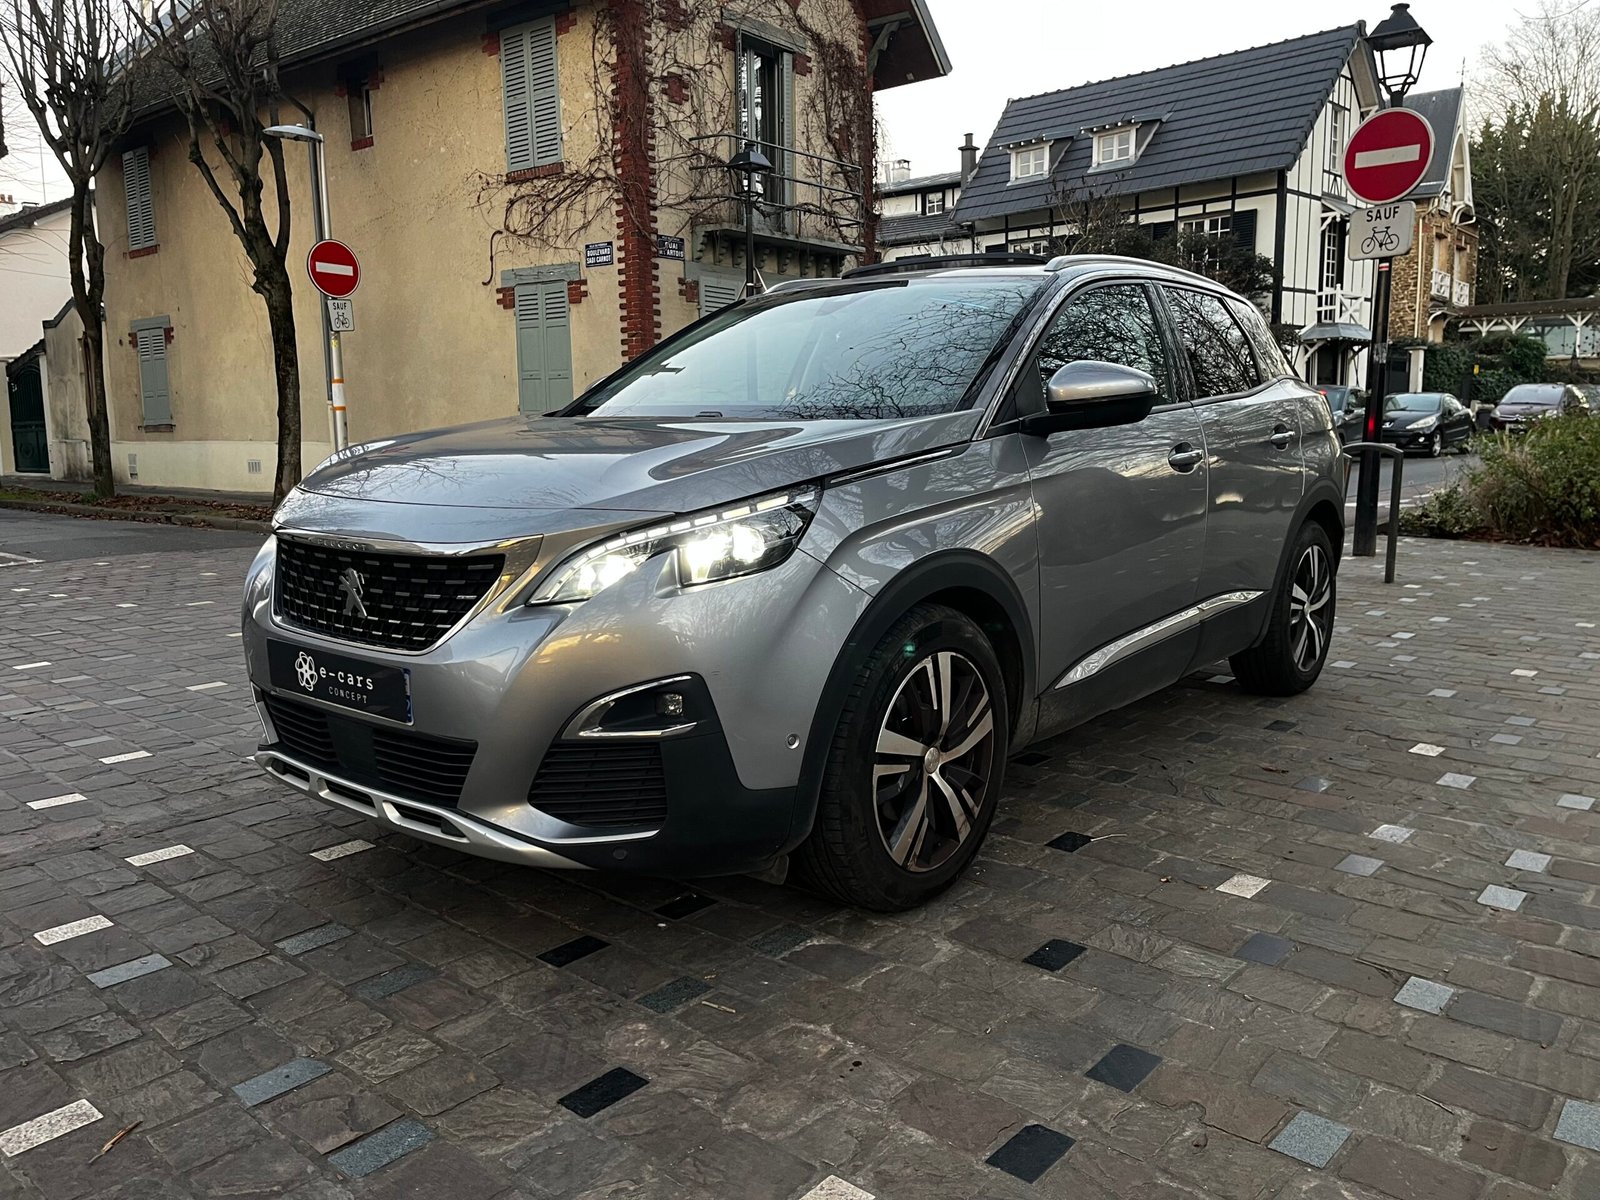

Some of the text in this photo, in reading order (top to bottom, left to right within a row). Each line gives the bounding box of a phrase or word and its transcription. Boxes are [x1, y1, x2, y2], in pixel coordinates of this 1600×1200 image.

[1366, 206, 1400, 222] SAUF
[587, 247, 611, 257] BOULEVARD
[586, 255, 611, 264] SADI CARNOT
[332, 302, 347, 310] SAUF
[317, 539, 367, 551] PEUGEOT
[319, 666, 374, 690] e-cars
[328, 686, 368, 704] CONCEPT
